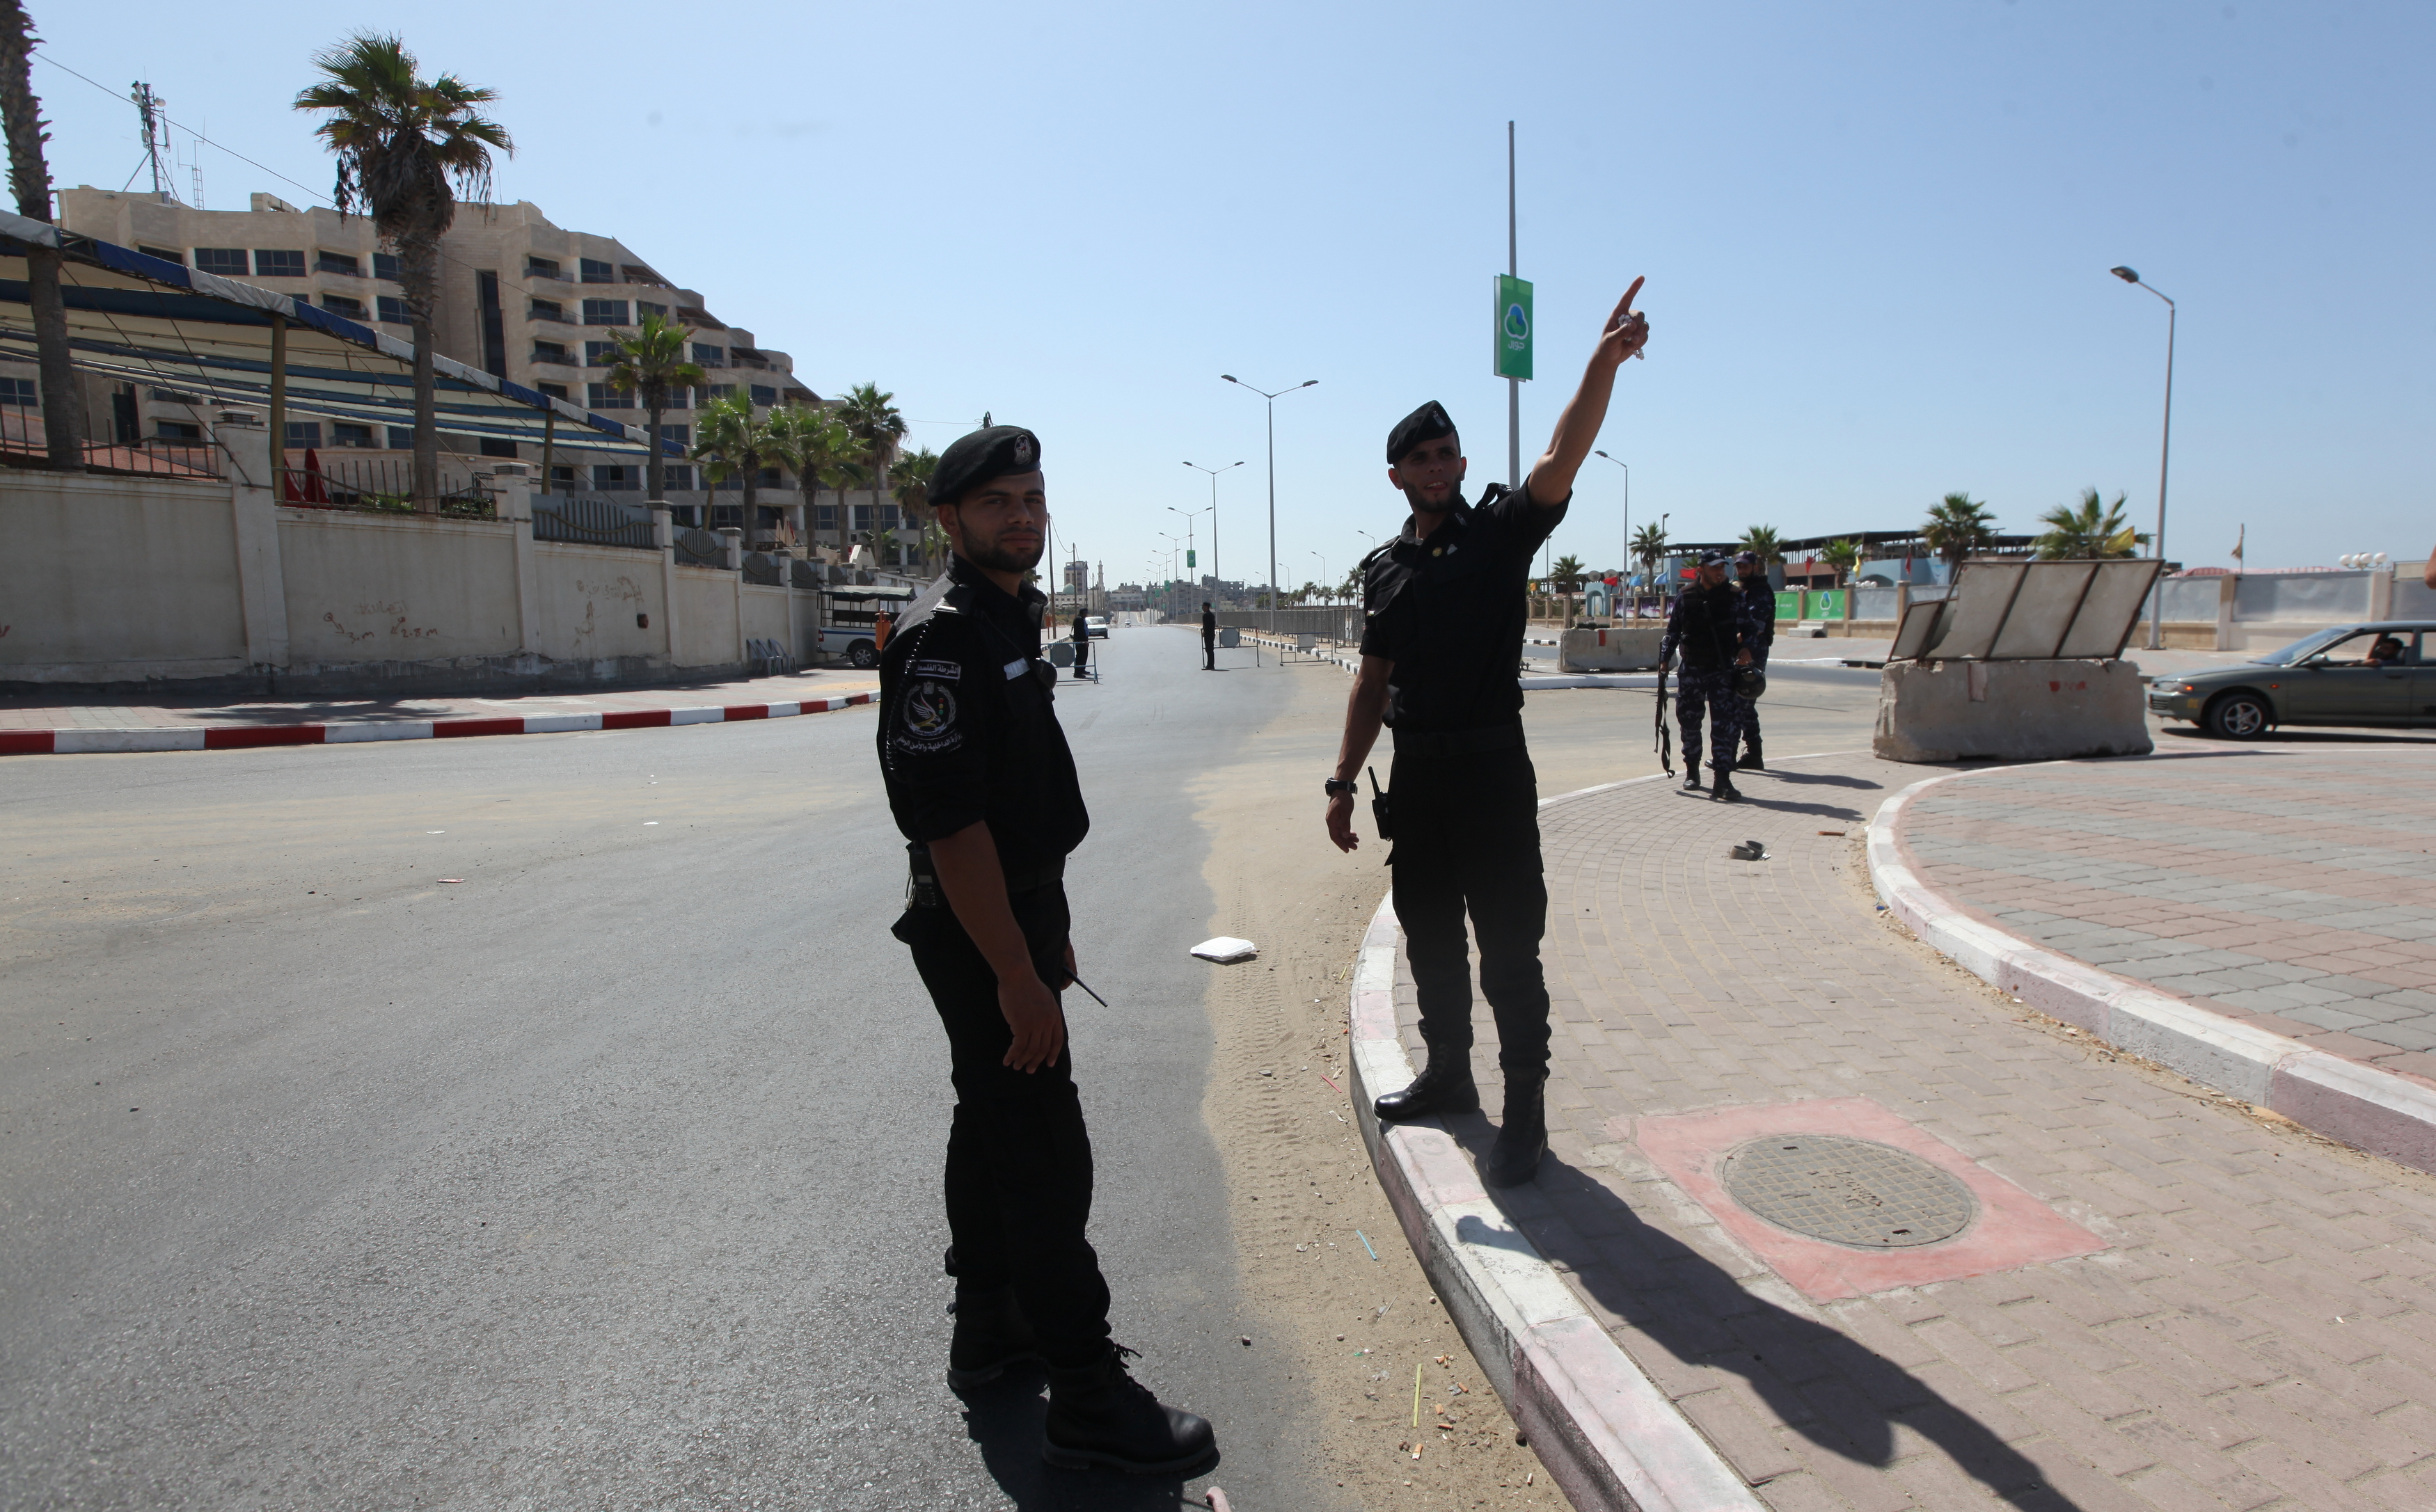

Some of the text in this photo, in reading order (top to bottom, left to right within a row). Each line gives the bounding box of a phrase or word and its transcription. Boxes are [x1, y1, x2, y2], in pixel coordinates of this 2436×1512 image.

[1508, 340, 1525, 351] جوال
[401, 628, 421, 638] 2.8
[937, 664, 958, 675] الشرطة
[910, 740, 927, 752] والأمن
[928, 739, 951, 751] الداخلية
